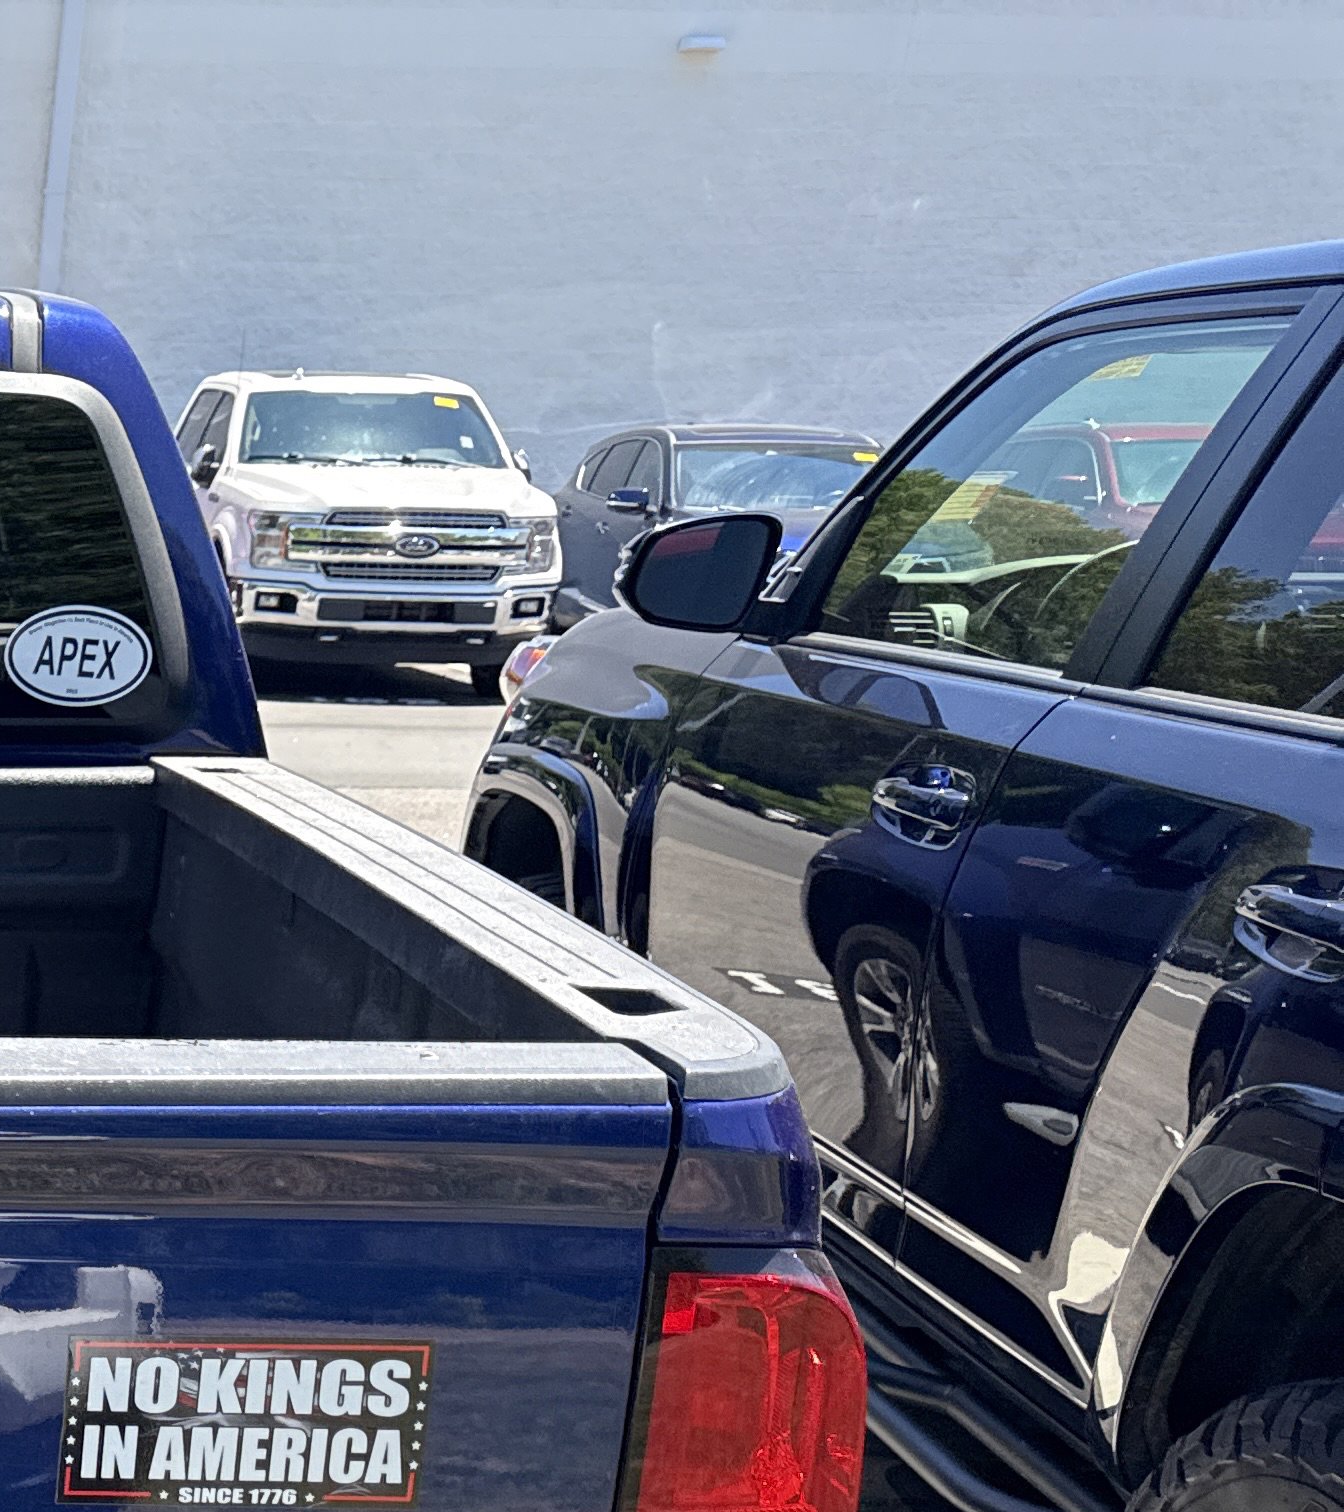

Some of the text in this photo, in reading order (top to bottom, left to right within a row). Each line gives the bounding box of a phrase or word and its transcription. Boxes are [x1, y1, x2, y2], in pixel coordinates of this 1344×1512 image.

[33, 635, 121, 680] APEX
[86, 1357, 411, 1418] NO KINGS
[80, 1424, 403, 1484] IN AMERICA
[178, 1487, 297, 1505] SINCE 1776
